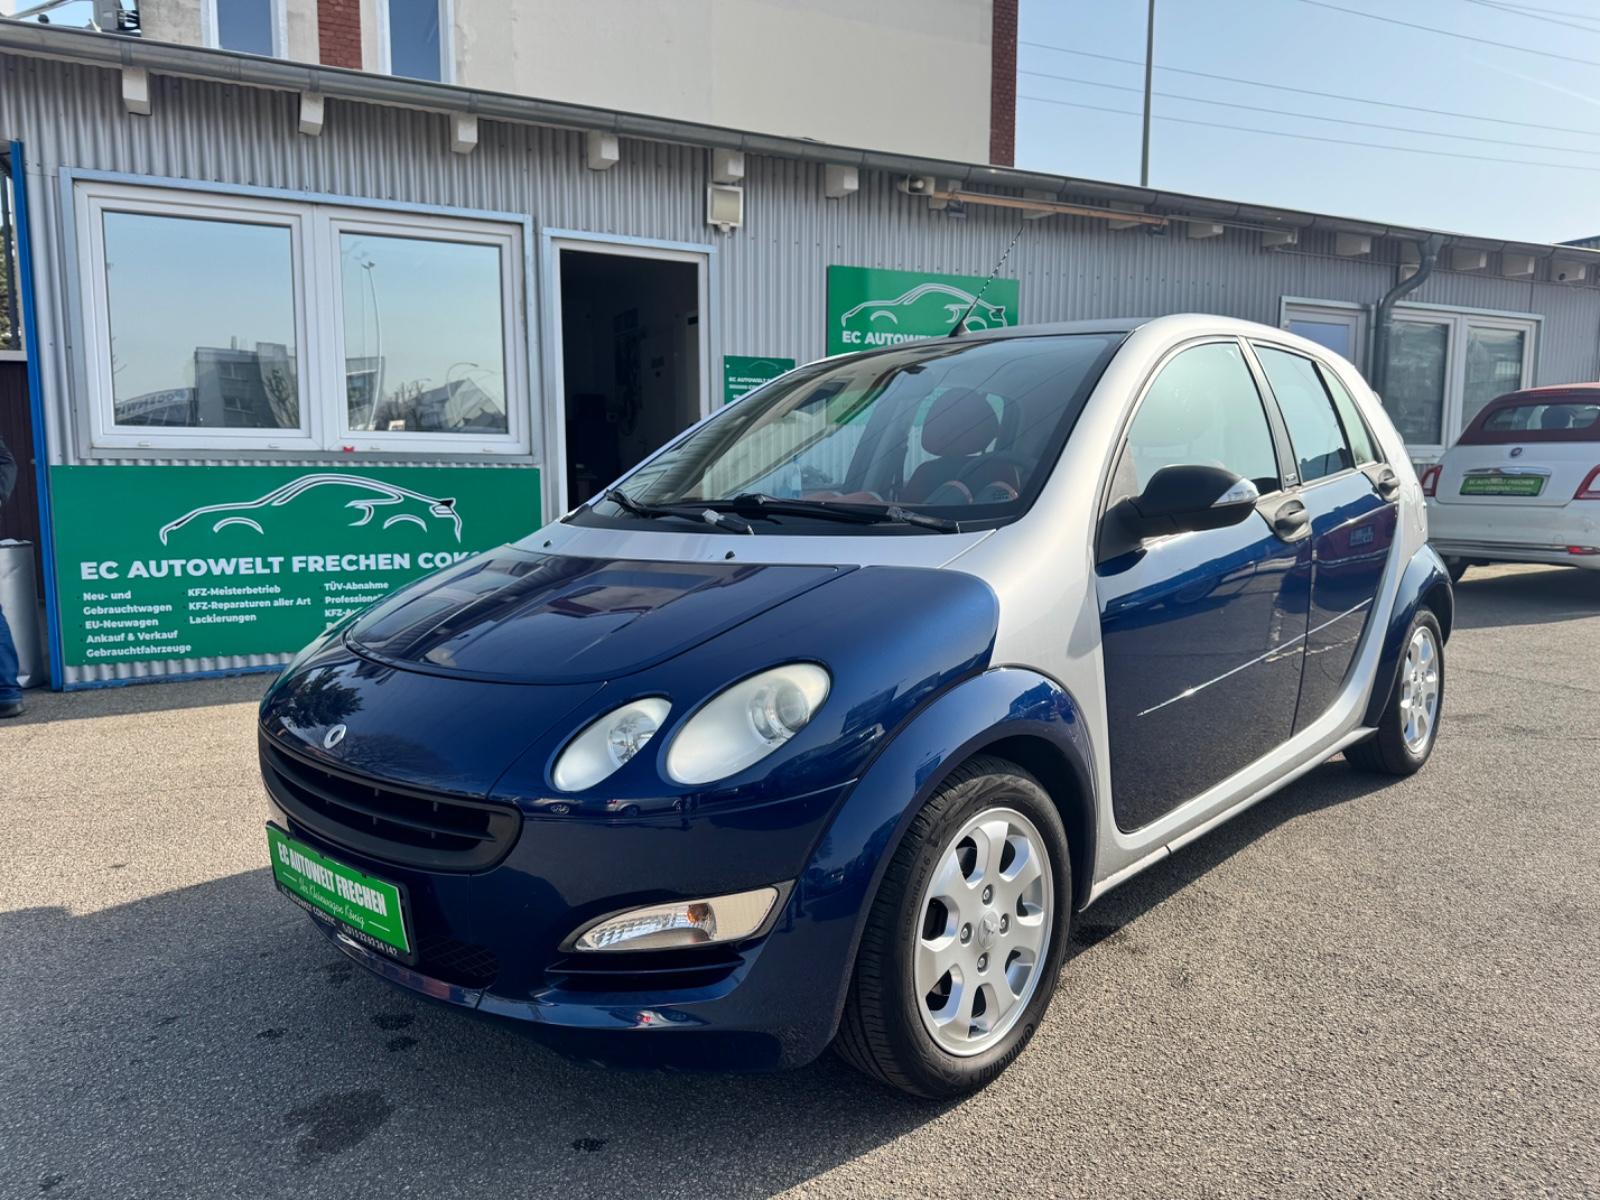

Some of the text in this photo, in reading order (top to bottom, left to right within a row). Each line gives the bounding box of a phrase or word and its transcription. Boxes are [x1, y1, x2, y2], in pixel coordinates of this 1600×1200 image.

[842, 330, 932, 346] EC AUTOW
[80, 551, 481, 580] EC AUTOWELT FRECHEN COK
[187, 584, 282, 597] KFZ-Meisterbetrieb
[324, 581, 389, 591] TÜV-Abnahme
[83, 590, 132, 601] Neu- und
[83, 604, 173, 615] Gebrauchtwagen
[188, 597, 312, 611] KFZ-Reparaturen aller Art
[85, 619, 159, 629] EU-Neuwagen
[189, 613, 257, 624] Lackierungen
[86, 630, 178, 643] Ankauf & Verkauf
[86, 644, 192, 657] Gebrauchtfahrzeuge
[277, 841, 290, 866] EC
[289, 848, 335, 893] AUTOWELT
[335, 873, 388, 917] FRECHEN
